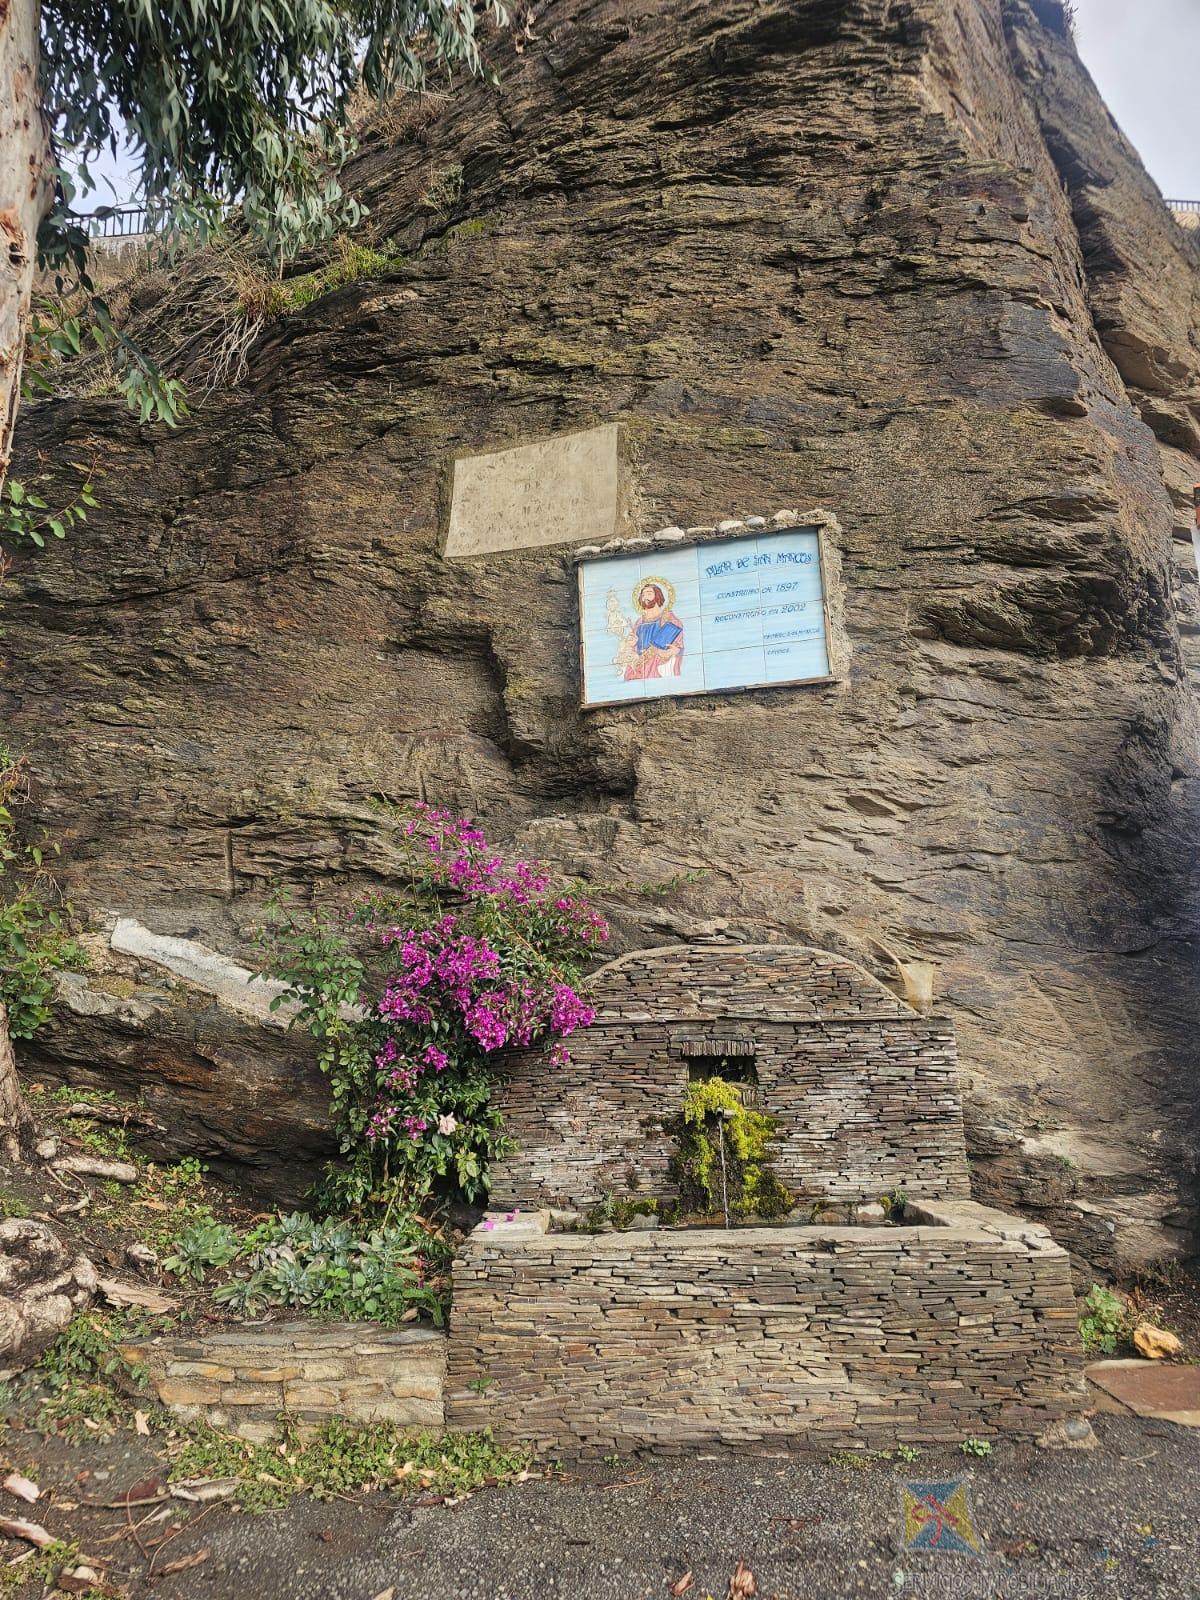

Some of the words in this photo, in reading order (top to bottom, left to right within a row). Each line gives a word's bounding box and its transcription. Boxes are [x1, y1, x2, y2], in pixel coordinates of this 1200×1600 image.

[706, 562, 734, 578] PILAR
[736, 556, 750, 568] DE
[753, 553, 771, 566] SAN
[777, 552, 812, 565] MARCOS
[781, 602, 807, 614] 2002
